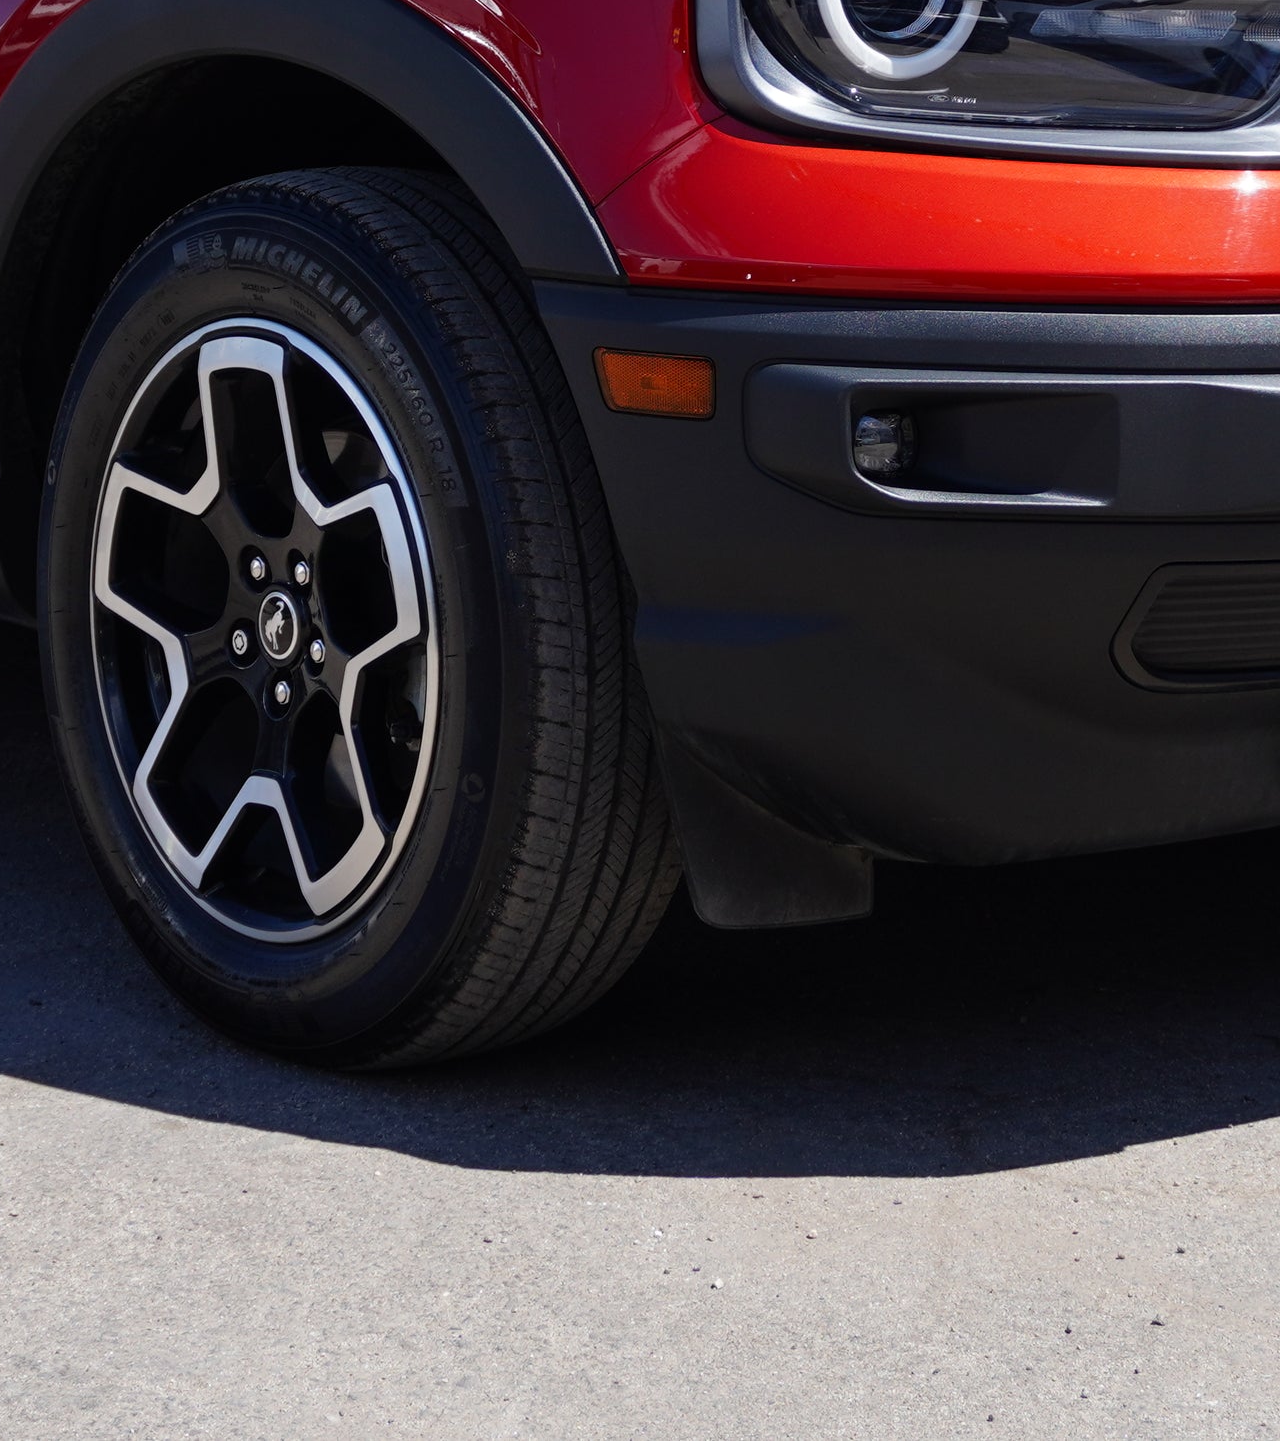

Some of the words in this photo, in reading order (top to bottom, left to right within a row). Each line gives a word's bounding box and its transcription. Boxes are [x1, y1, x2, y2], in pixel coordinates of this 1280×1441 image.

[230, 236, 368, 326] MICHELIN
[379, 341, 434, 428] 225/60
[437, 465, 458, 493] 18
